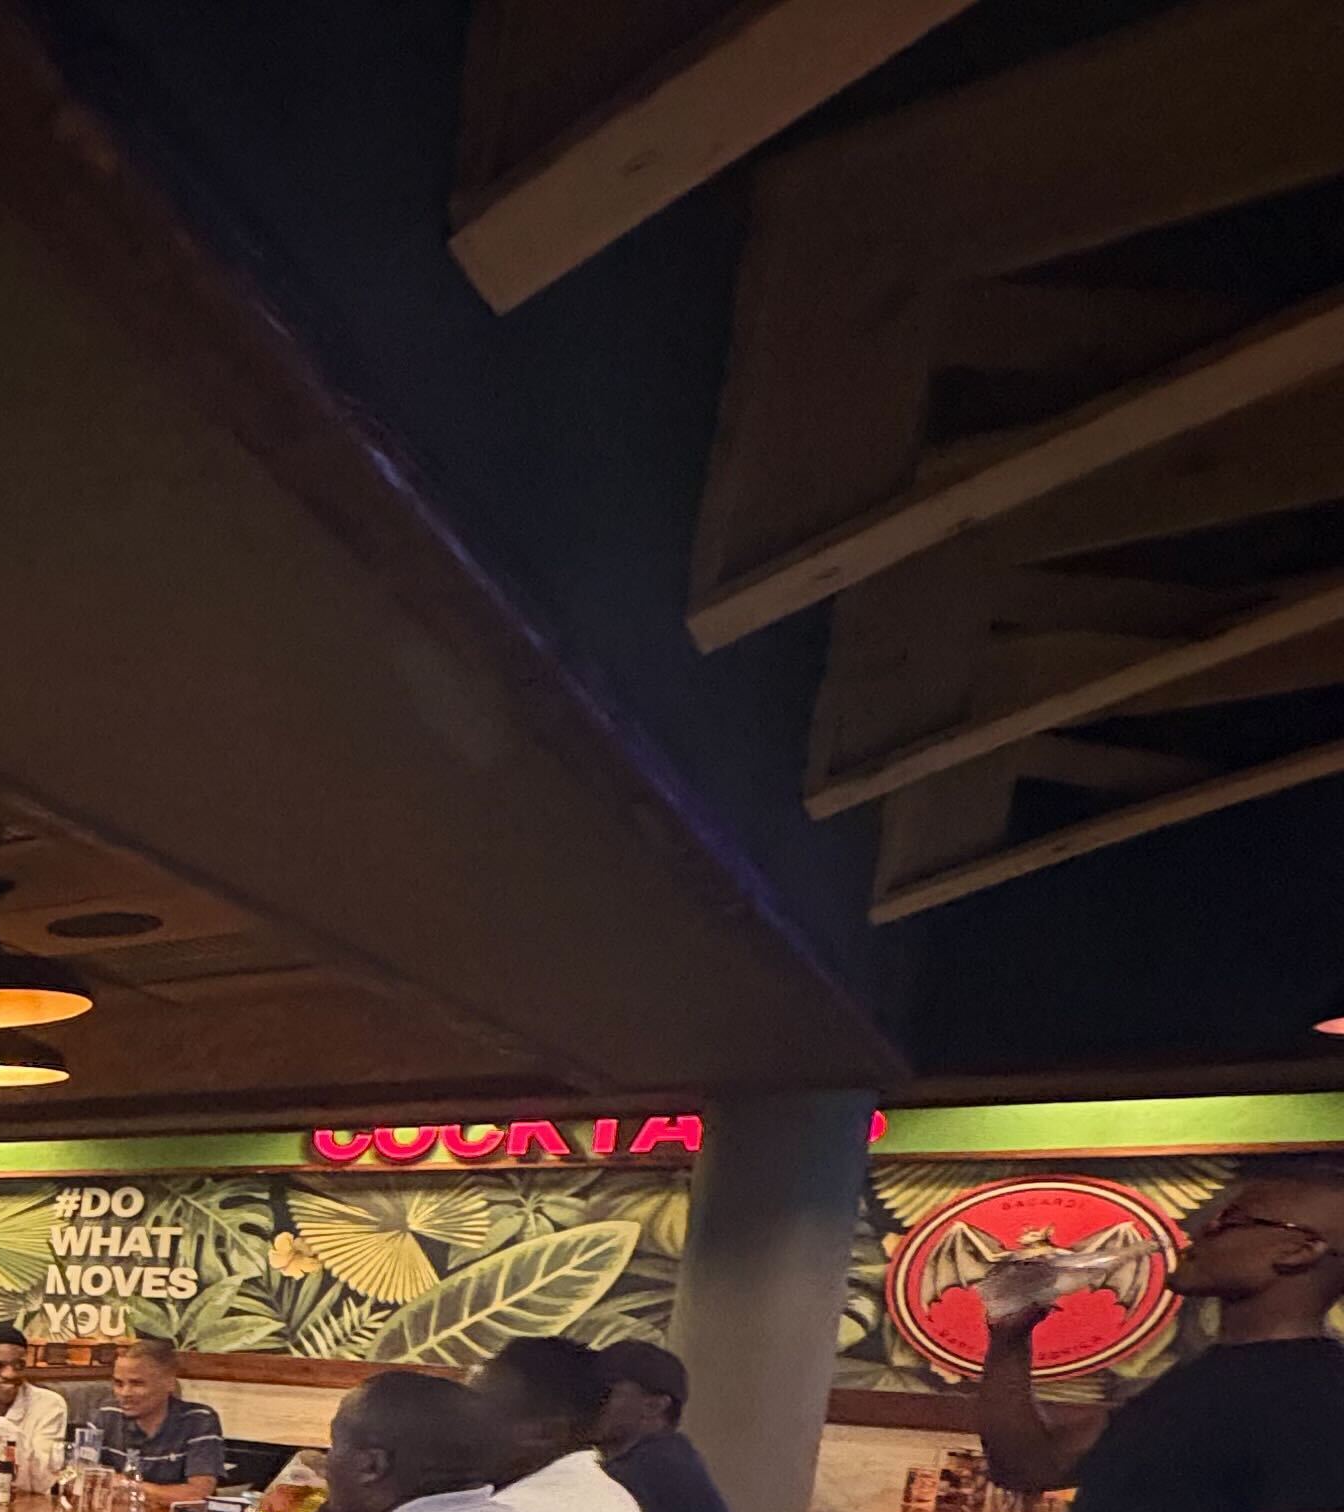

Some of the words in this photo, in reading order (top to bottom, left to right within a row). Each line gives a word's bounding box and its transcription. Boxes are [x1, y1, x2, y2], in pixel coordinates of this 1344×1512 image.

[55, 1186, 145, 1219] #DO
[50, 1225, 184, 1259] WHAT
[45, 1263, 199, 1300] MOVES
[43, 1302, 127, 1337] YOU
